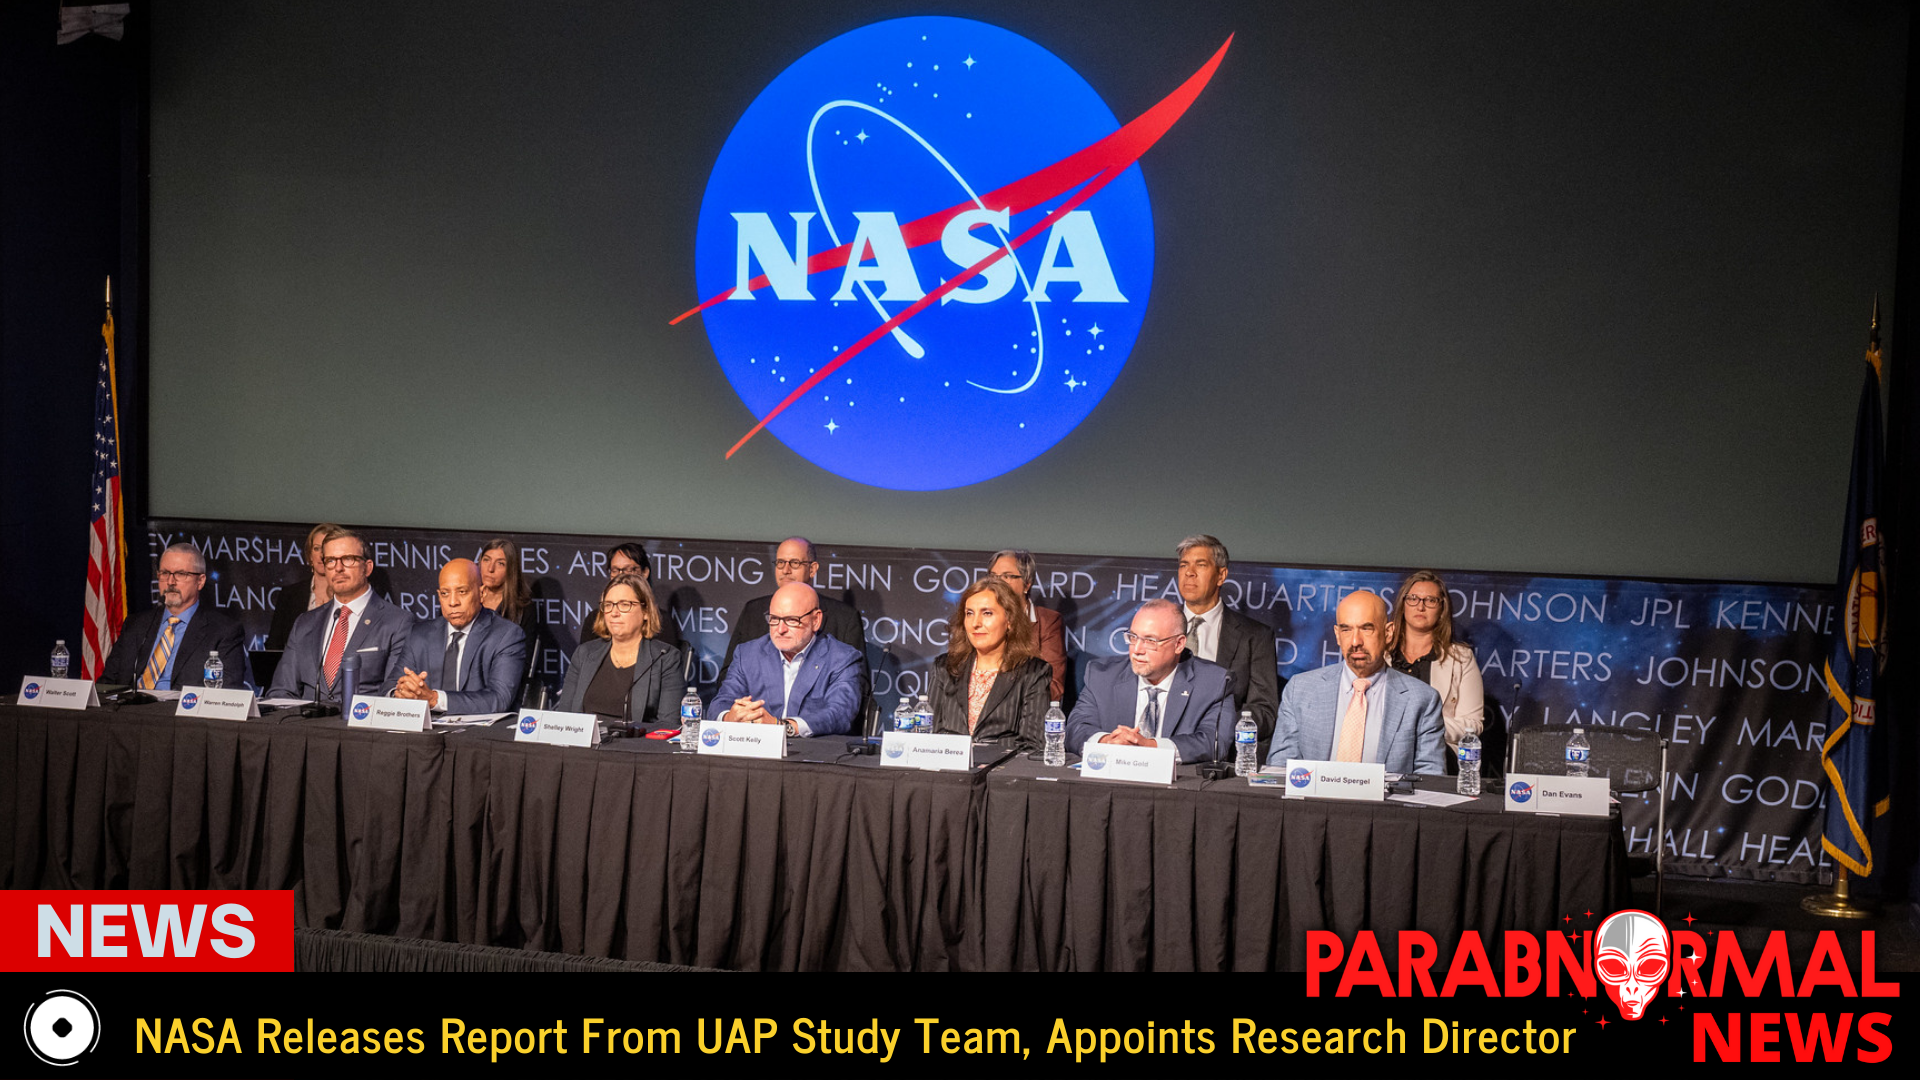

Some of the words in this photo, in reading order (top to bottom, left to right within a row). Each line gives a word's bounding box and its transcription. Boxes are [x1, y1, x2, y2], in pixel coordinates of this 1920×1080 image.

[730, 206, 1130, 307] NASA
[191, 535, 309, 566] MARSHA
[370, 541, 452, 571] ENNIS
[567, 548, 765, 585] ARTRONG
[1630, 597, 1691, 630] JPL
[1636, 655, 1830, 694] JOHNSON
[46, 689, 62, 697] Walter
[376, 709, 395, 718] Reggie
[543, 723, 564, 733] Shelley
[565, 726, 584, 734] Wright
[728, 735, 744, 743] Scott
[745, 736, 762, 744] Kelly
[912, 746, 943, 755] Anamaria
[944, 748, 964, 756] Berea
[1115, 758, 1131, 766] Mike
[1132, 760, 1149, 768] Gold
[1320, 775, 1341, 784] David
[1342, 776, 1371, 786] Spergel
[1542, 790, 1558, 798] Dan
[1559, 791, 1583, 799] Evans
[1721, 773, 1827, 810] GOD
[1622, 825, 1716, 860] HALL
